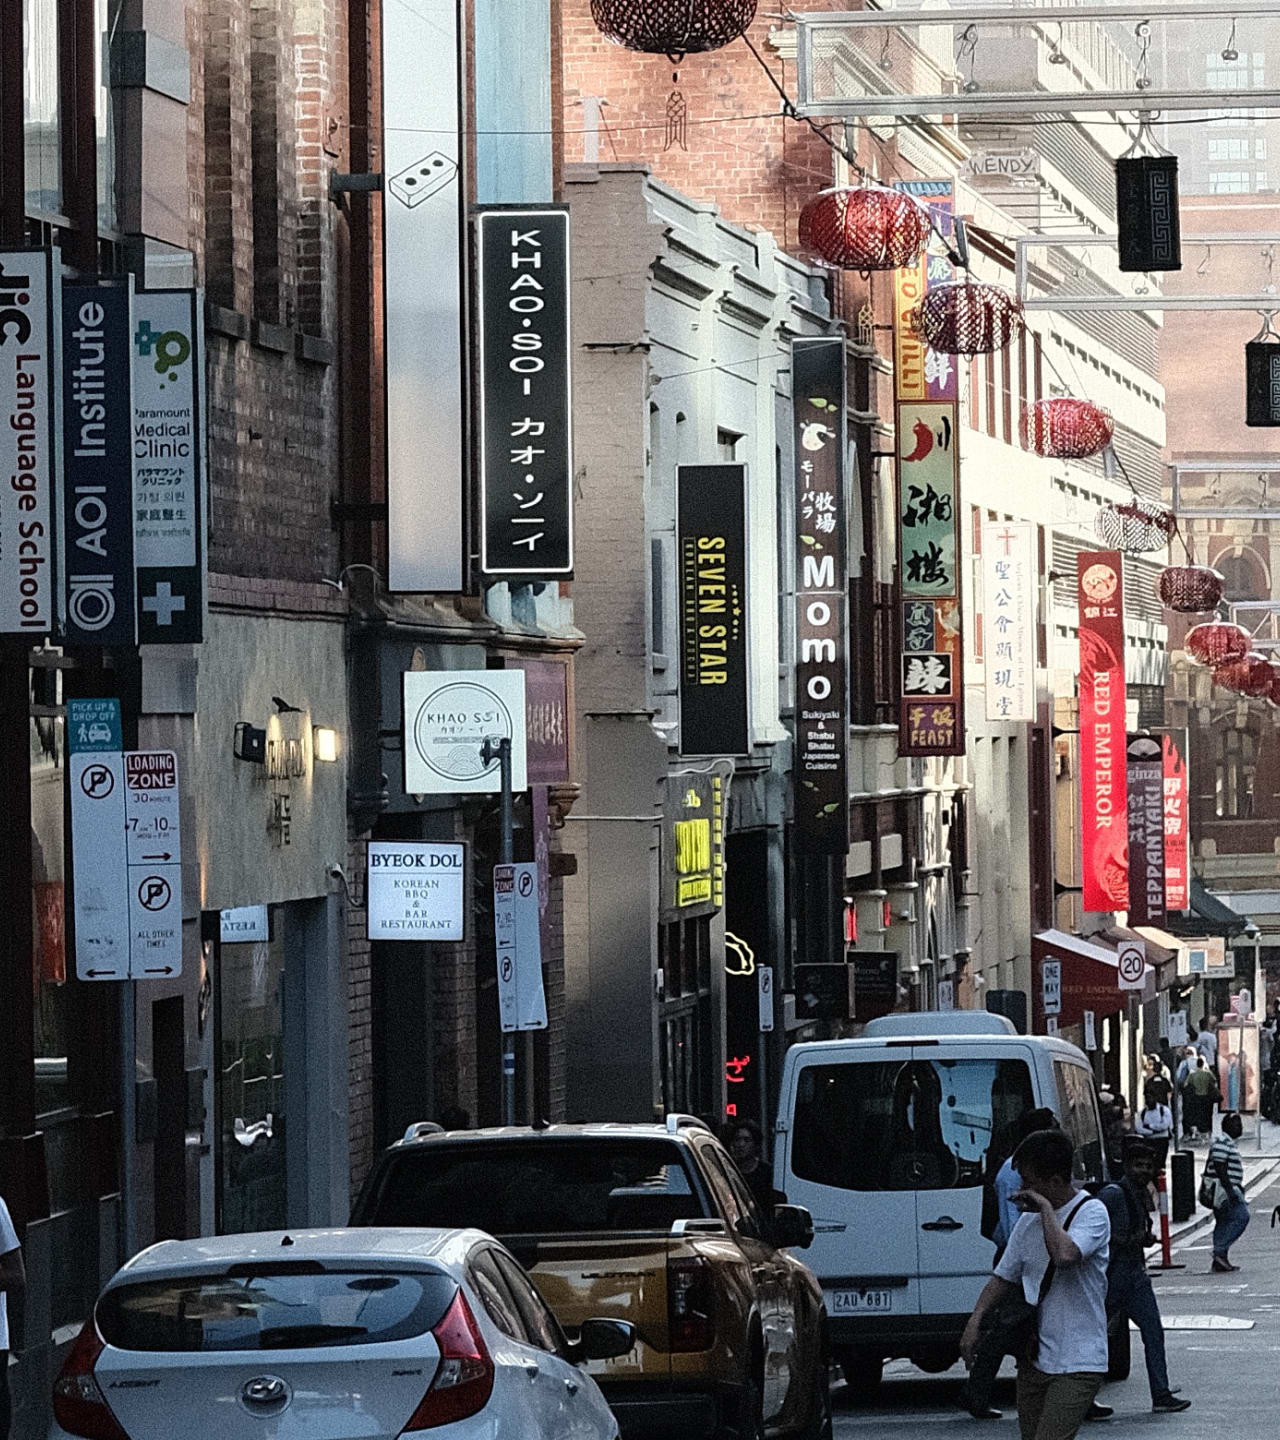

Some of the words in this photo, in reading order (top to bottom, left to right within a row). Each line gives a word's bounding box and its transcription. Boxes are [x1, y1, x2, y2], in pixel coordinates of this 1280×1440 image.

[73, 300, 106, 458] Institute
[135, 408, 190, 419] aramount
[11, 355, 41, 512] Language
[134, 422, 190, 437] Medical
[134, 439, 190, 459] Clinic
[74, 486, 108, 557] AOI
[18, 522, 46, 628] School
[697, 536, 726, 613] SEVEN
[802, 555, 836, 700] Momo
[699, 625, 728, 684] STAR
[1093, 671, 1111, 716] RED
[72, 702, 94, 712] PICK
[95, 702, 107, 711] UP
[801, 709, 840, 720] Sukiyaki
[72, 712, 97, 721] DROP
[99, 712, 116, 721] OFF
[427, 712, 467, 724] KHAO
[807, 731, 835, 740] Shabu
[910, 729, 954, 747] FEAST
[807, 741, 835, 750] Shabu
[128, 755, 173, 771] LOADING
[802, 751, 840, 761] Japanese
[805, 761, 838, 771] Cuisine
[128, 773, 175, 788] ZONE
[1094, 721, 1112, 830] EMPEROR
[1127, 767, 1162, 783] ginza
[132, 793, 149, 803] 30
[1145, 785, 1163, 920] TEPPANYAKI
[371, 853, 426, 868] BYEOK
[430, 853, 463, 868] DOL
[394, 879, 439, 888] KOREAN
[404, 890, 429, 900] BBQ
[412, 900, 420, 908] &
[404, 910, 428, 919] BAR
[381, 920, 452, 929] RESTAURANT
[1045, 965, 1058, 978] ONE
[1123, 957, 1141, 974] 20
[1045, 983, 1059, 994] WAY
